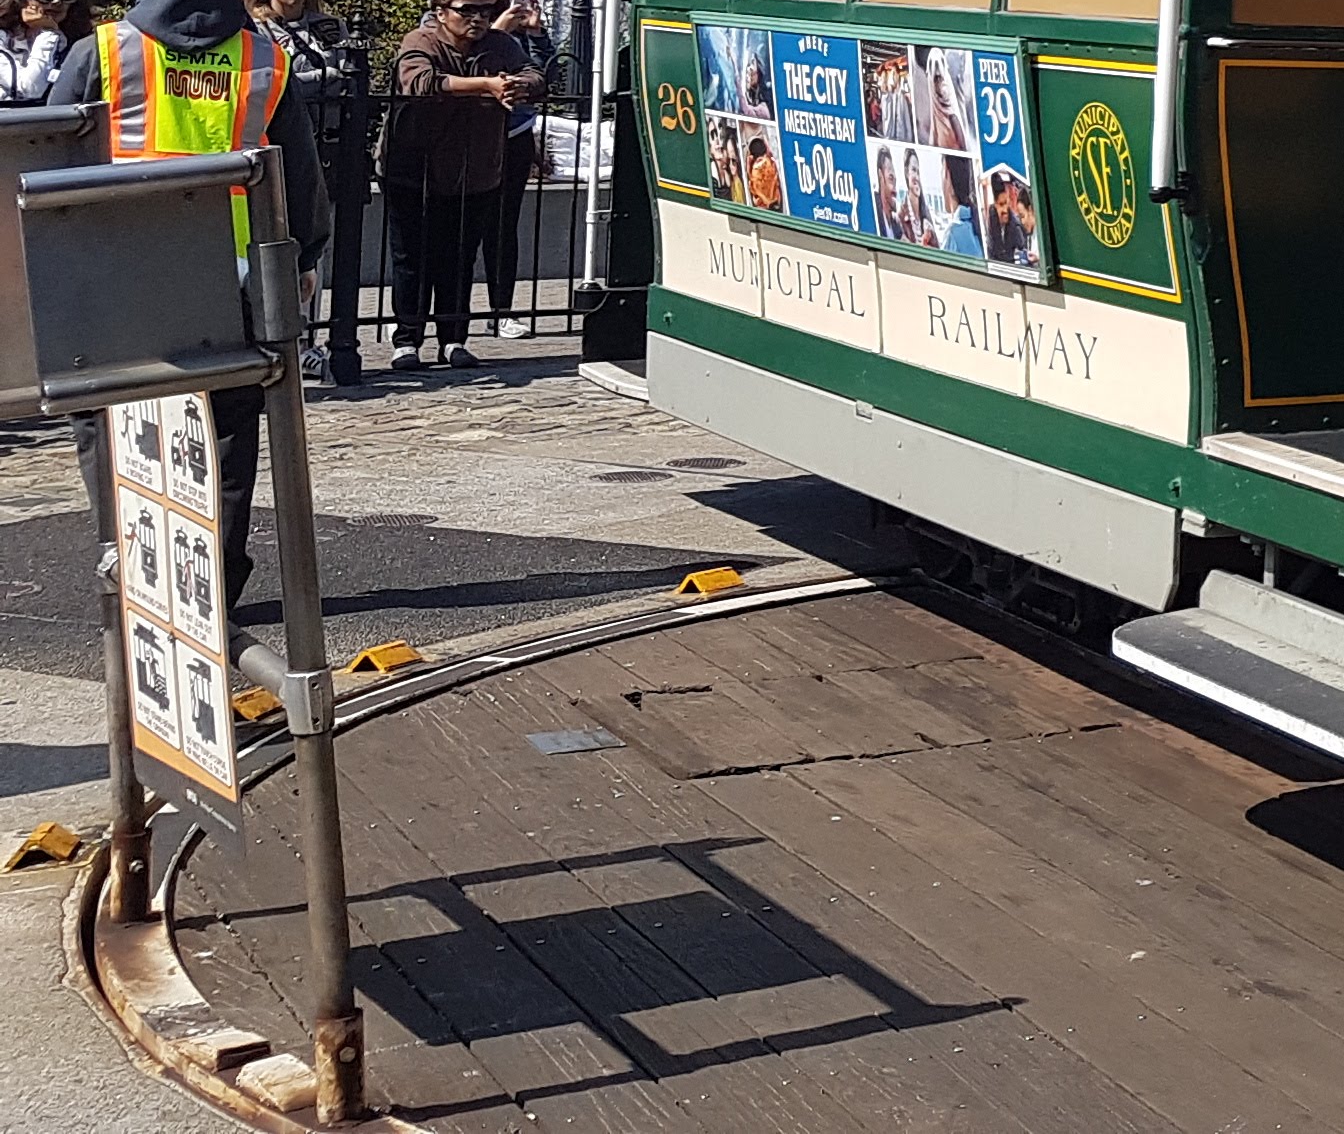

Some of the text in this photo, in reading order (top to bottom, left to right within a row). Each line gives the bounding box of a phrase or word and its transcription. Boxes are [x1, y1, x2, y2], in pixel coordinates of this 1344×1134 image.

[798, 35, 829, 57] WHERE
[978, 58, 1010, 85] PIER
[658, 82, 696, 135] 26
[783, 62, 848, 107] THE CITY
[785, 108, 856, 144] MEETS THE BAY
[980, 86, 1015, 145] 39
[1071, 107, 1131, 170] MUNICIPAL
[793, 140, 860, 232] to Play
[1077, 193, 1135, 244] RAILWAY
[708, 238, 1098, 379] MUNICIPAL RAILWAY
